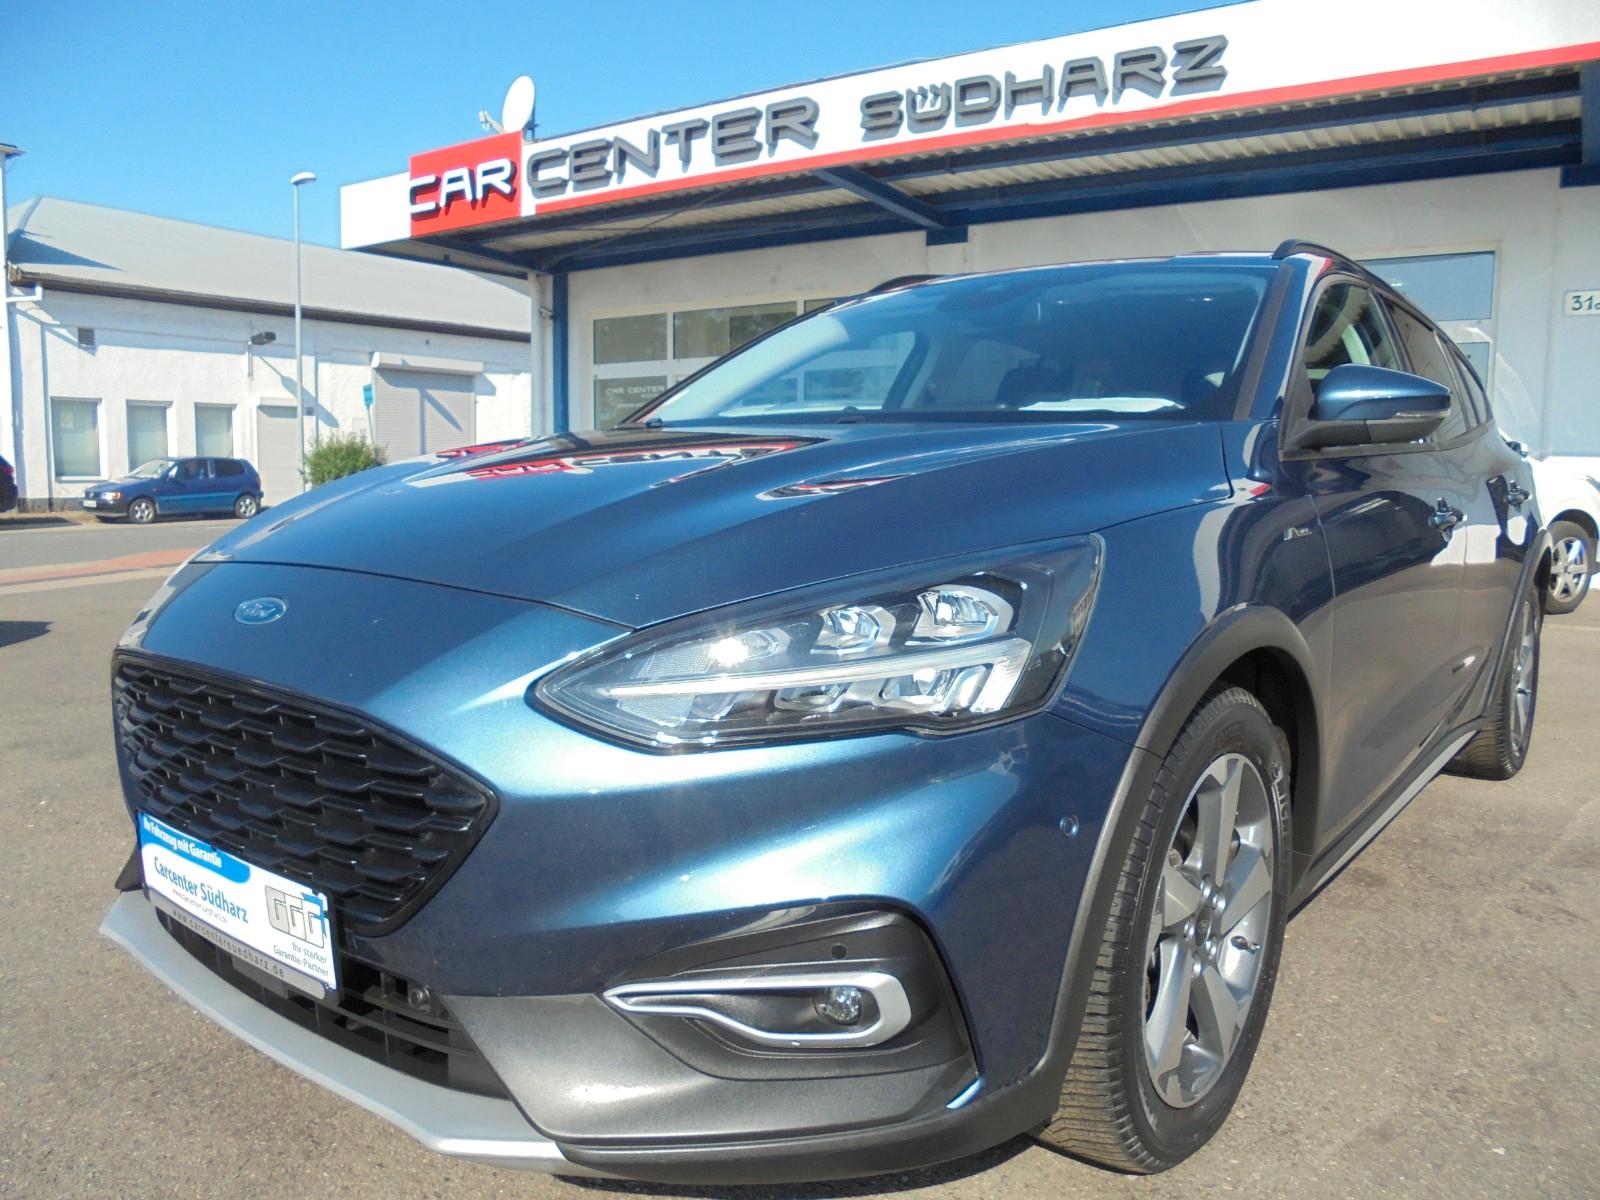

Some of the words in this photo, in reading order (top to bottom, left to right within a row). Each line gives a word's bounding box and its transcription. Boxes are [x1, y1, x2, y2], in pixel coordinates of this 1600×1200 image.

[409, 157, 516, 219] CAR
[526, 96, 820, 197] CENTER
[860, 34, 1228, 140] SÜDHARZ
[177, 839, 190, 854] mit
[190, 842, 222, 868] Garantie
[154, 856, 198, 896] Carcenter
[200, 882, 248, 924] Südharz
